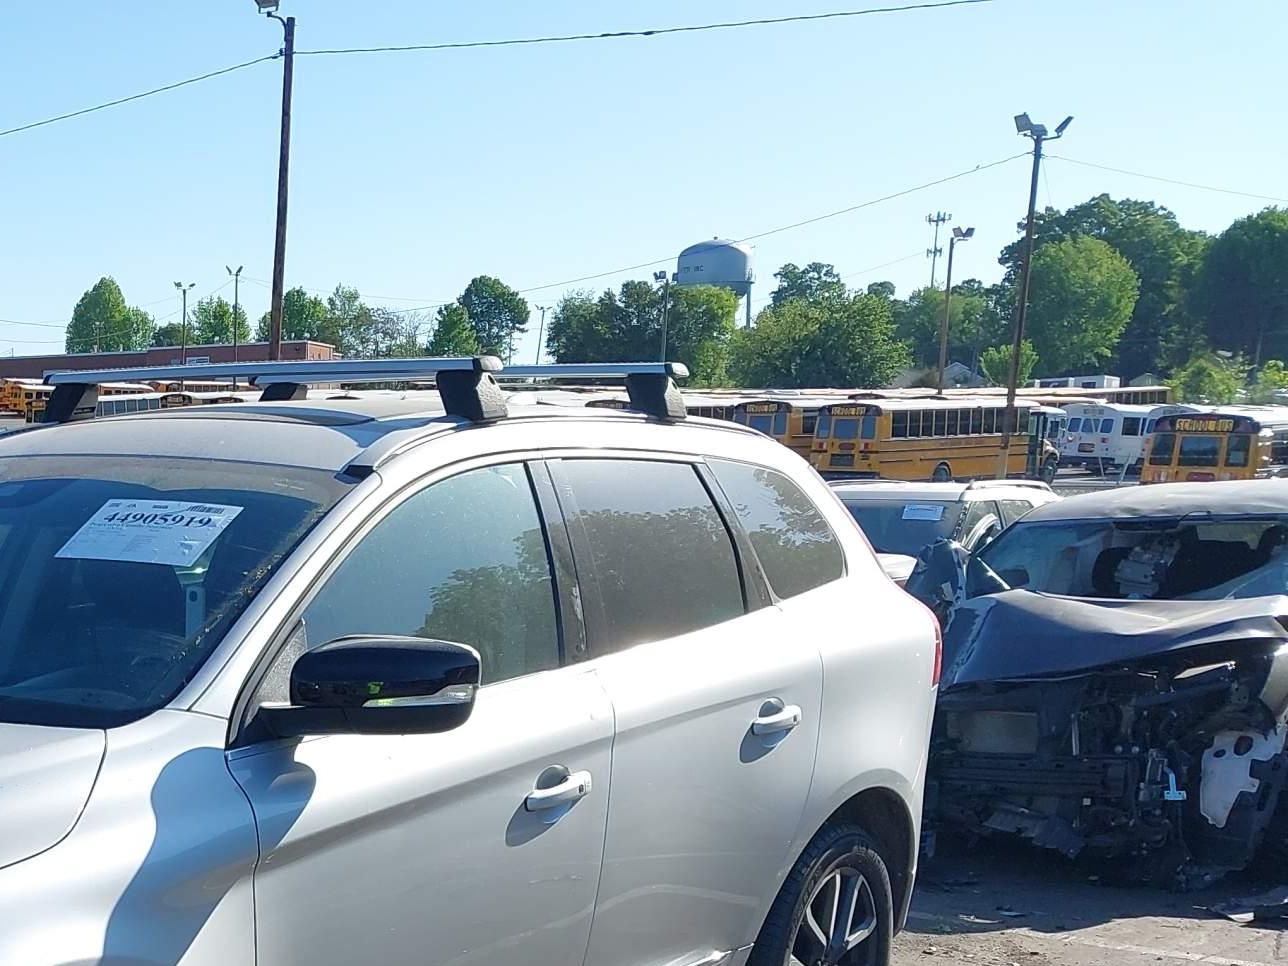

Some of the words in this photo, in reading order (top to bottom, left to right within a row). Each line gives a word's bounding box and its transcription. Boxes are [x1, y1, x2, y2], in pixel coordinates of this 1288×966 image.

[1177, 419, 1214, 431] SCHOOL
[1216, 420, 1233, 431] BUS
[103, 511, 213, 528] 44905919
